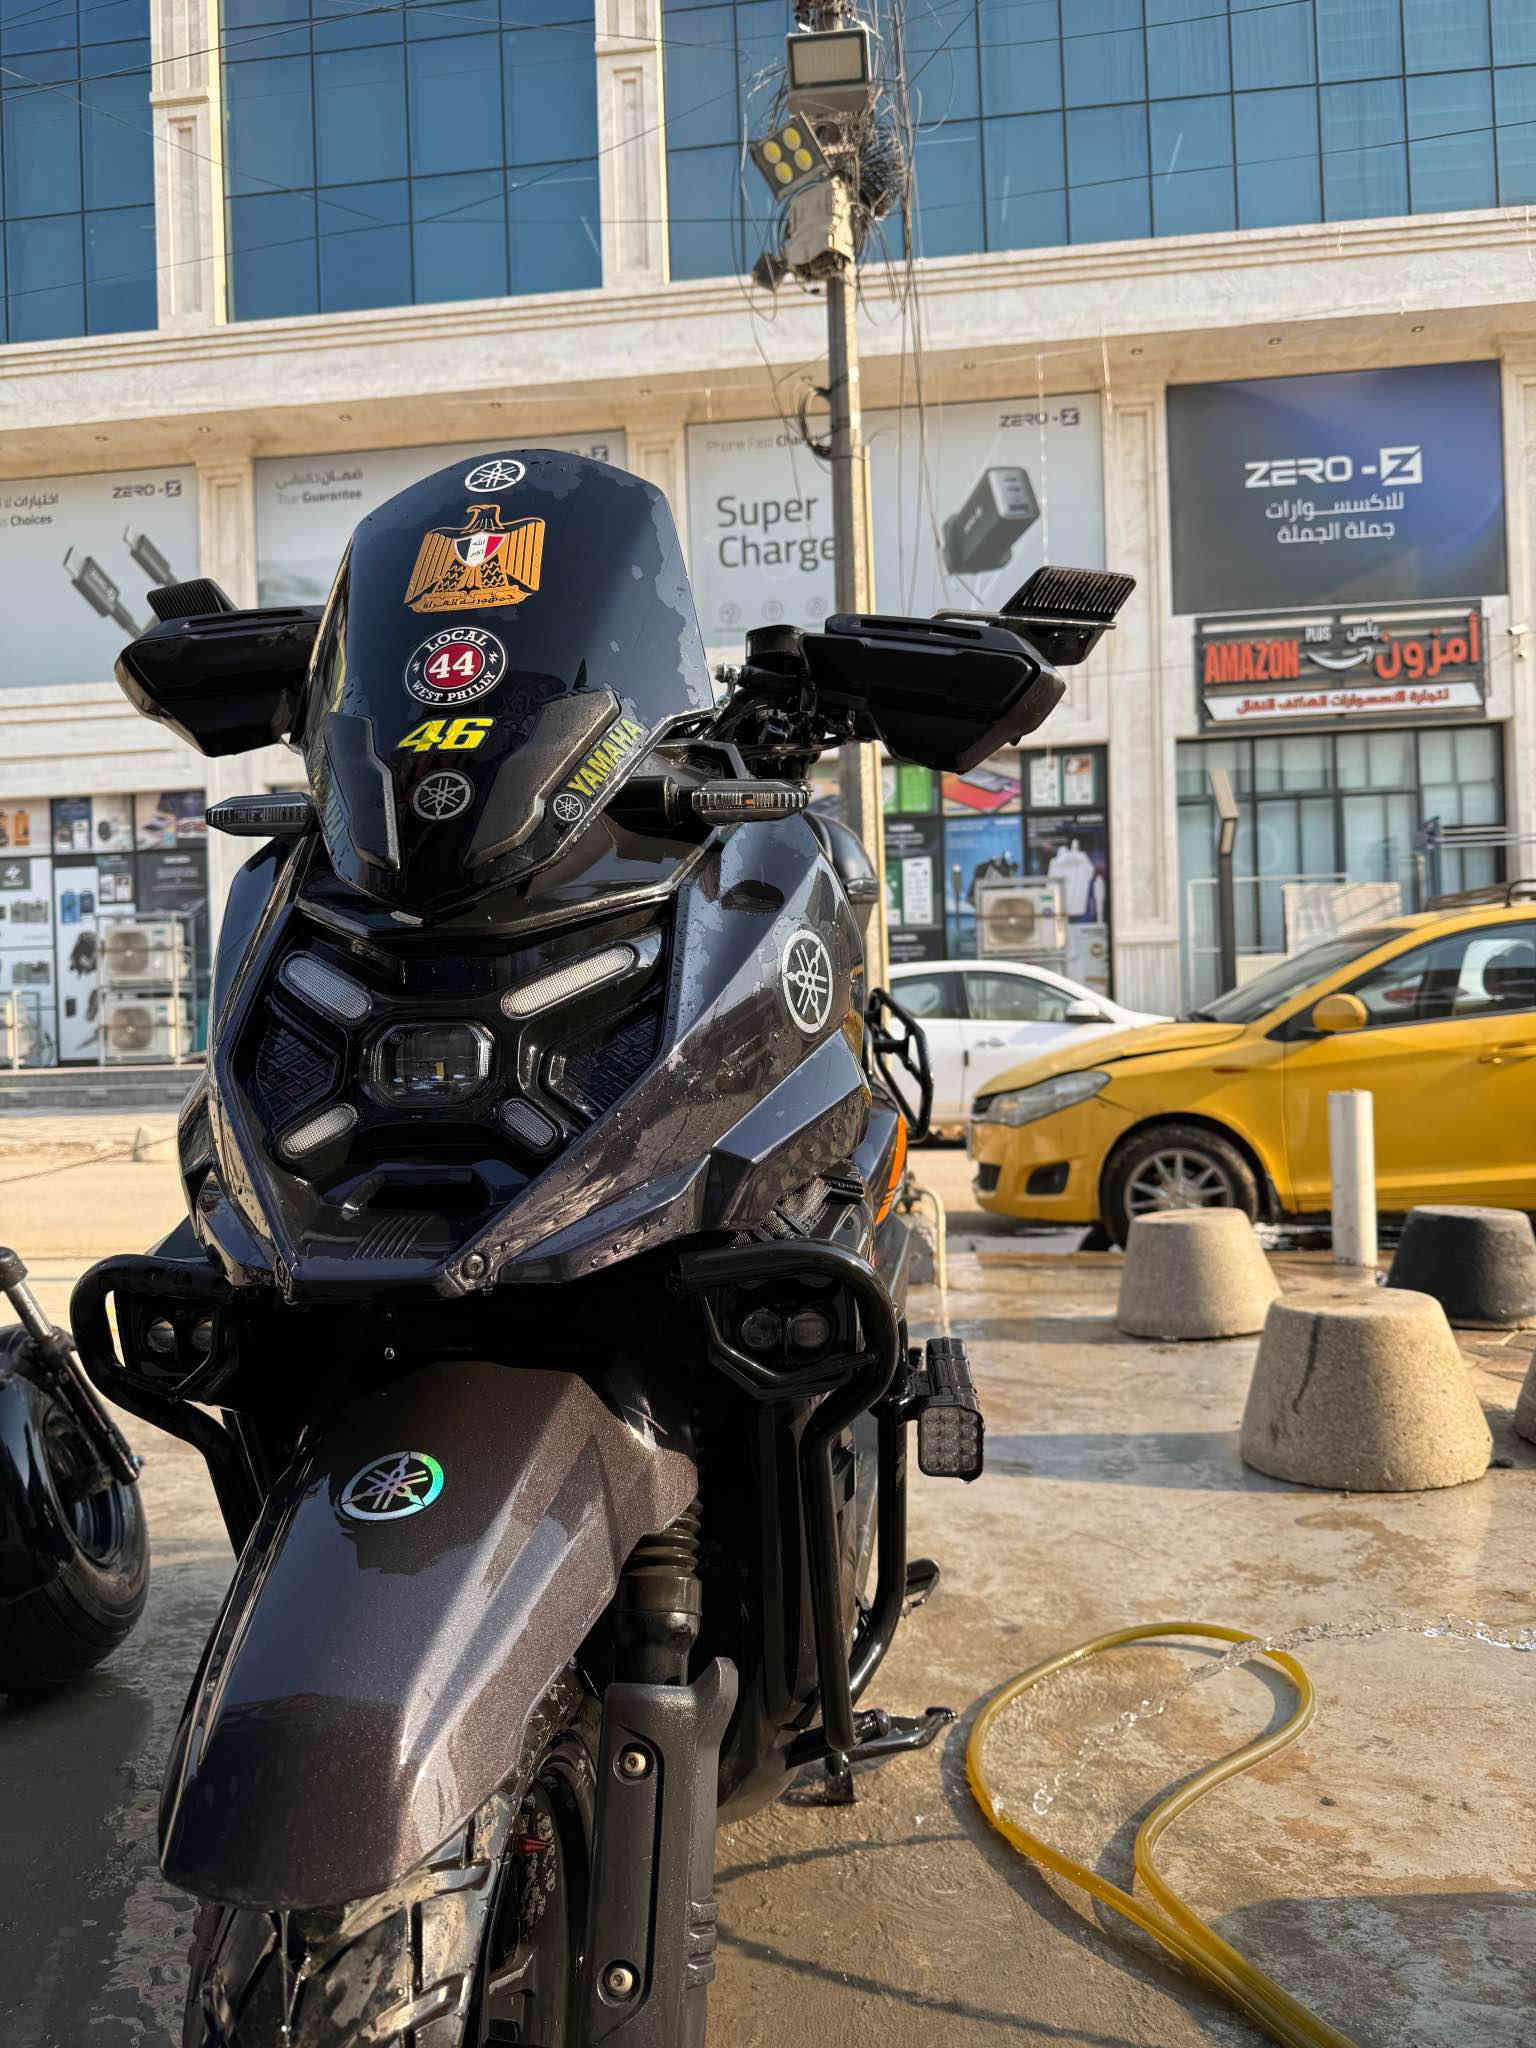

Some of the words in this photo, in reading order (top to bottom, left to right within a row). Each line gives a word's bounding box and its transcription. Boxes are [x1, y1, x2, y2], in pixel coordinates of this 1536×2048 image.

[1244, 455, 1353, 489] ZERO
[717, 495, 819, 534] Super
[1344, 520, 1396, 540] جملة
[1276, 522, 1341, 545] الجملة
[719, 535, 836, 573] Charge
[425, 630, 489, 652] LOCAL
[429, 651, 475, 679] 44
[1204, 640, 1299, 685] AMAZON
[412, 680, 444, 702] WEST
[447, 671, 496, 702] PHILLY
[397, 718, 494, 752] 46
[567, 719, 642, 797] YAMAHA
